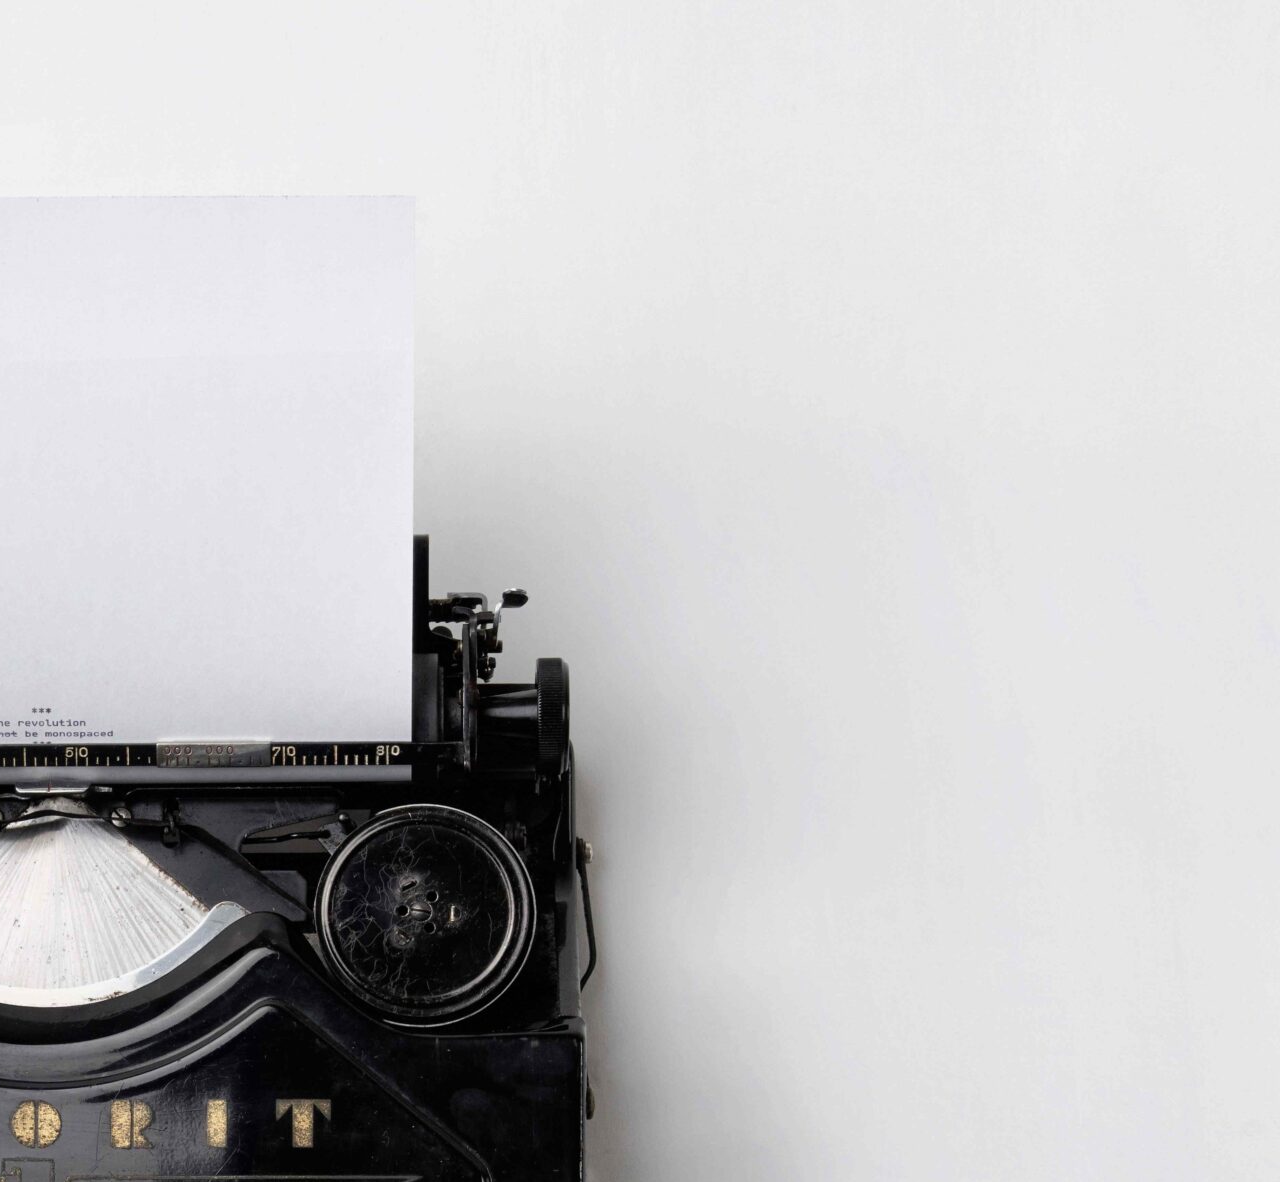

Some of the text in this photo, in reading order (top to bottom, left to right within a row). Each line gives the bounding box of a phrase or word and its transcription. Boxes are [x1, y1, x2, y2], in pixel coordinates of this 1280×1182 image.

[17, 719, 86, 727] revolution
[25, 730, 38, 738] be
[44, 730, 114, 739] monospaced
